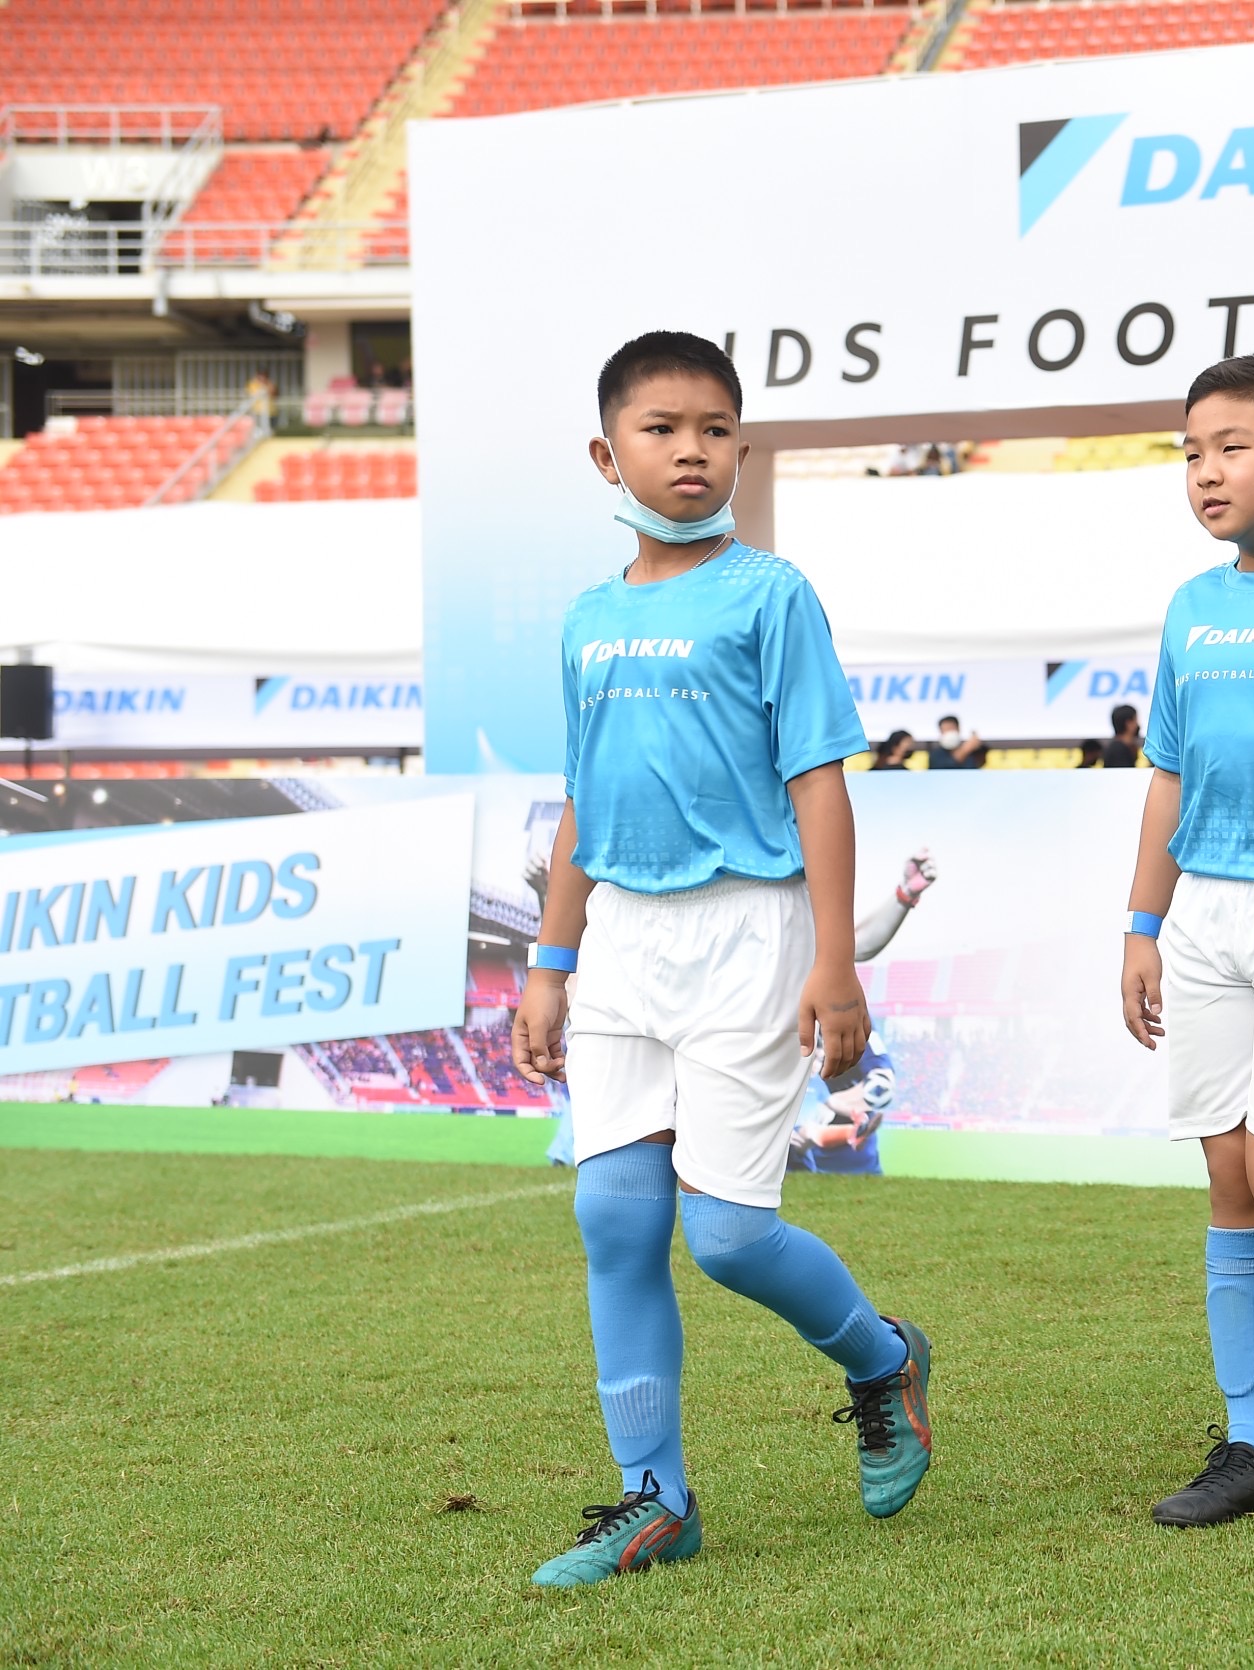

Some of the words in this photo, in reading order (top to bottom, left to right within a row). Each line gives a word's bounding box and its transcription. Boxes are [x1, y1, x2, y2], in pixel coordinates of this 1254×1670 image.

[595, 638, 694, 663] DAIKIN
[671, 688, 711, 702] FEST
[151, 852, 321, 934] KIDS
[218, 937, 402, 1023] FEST
